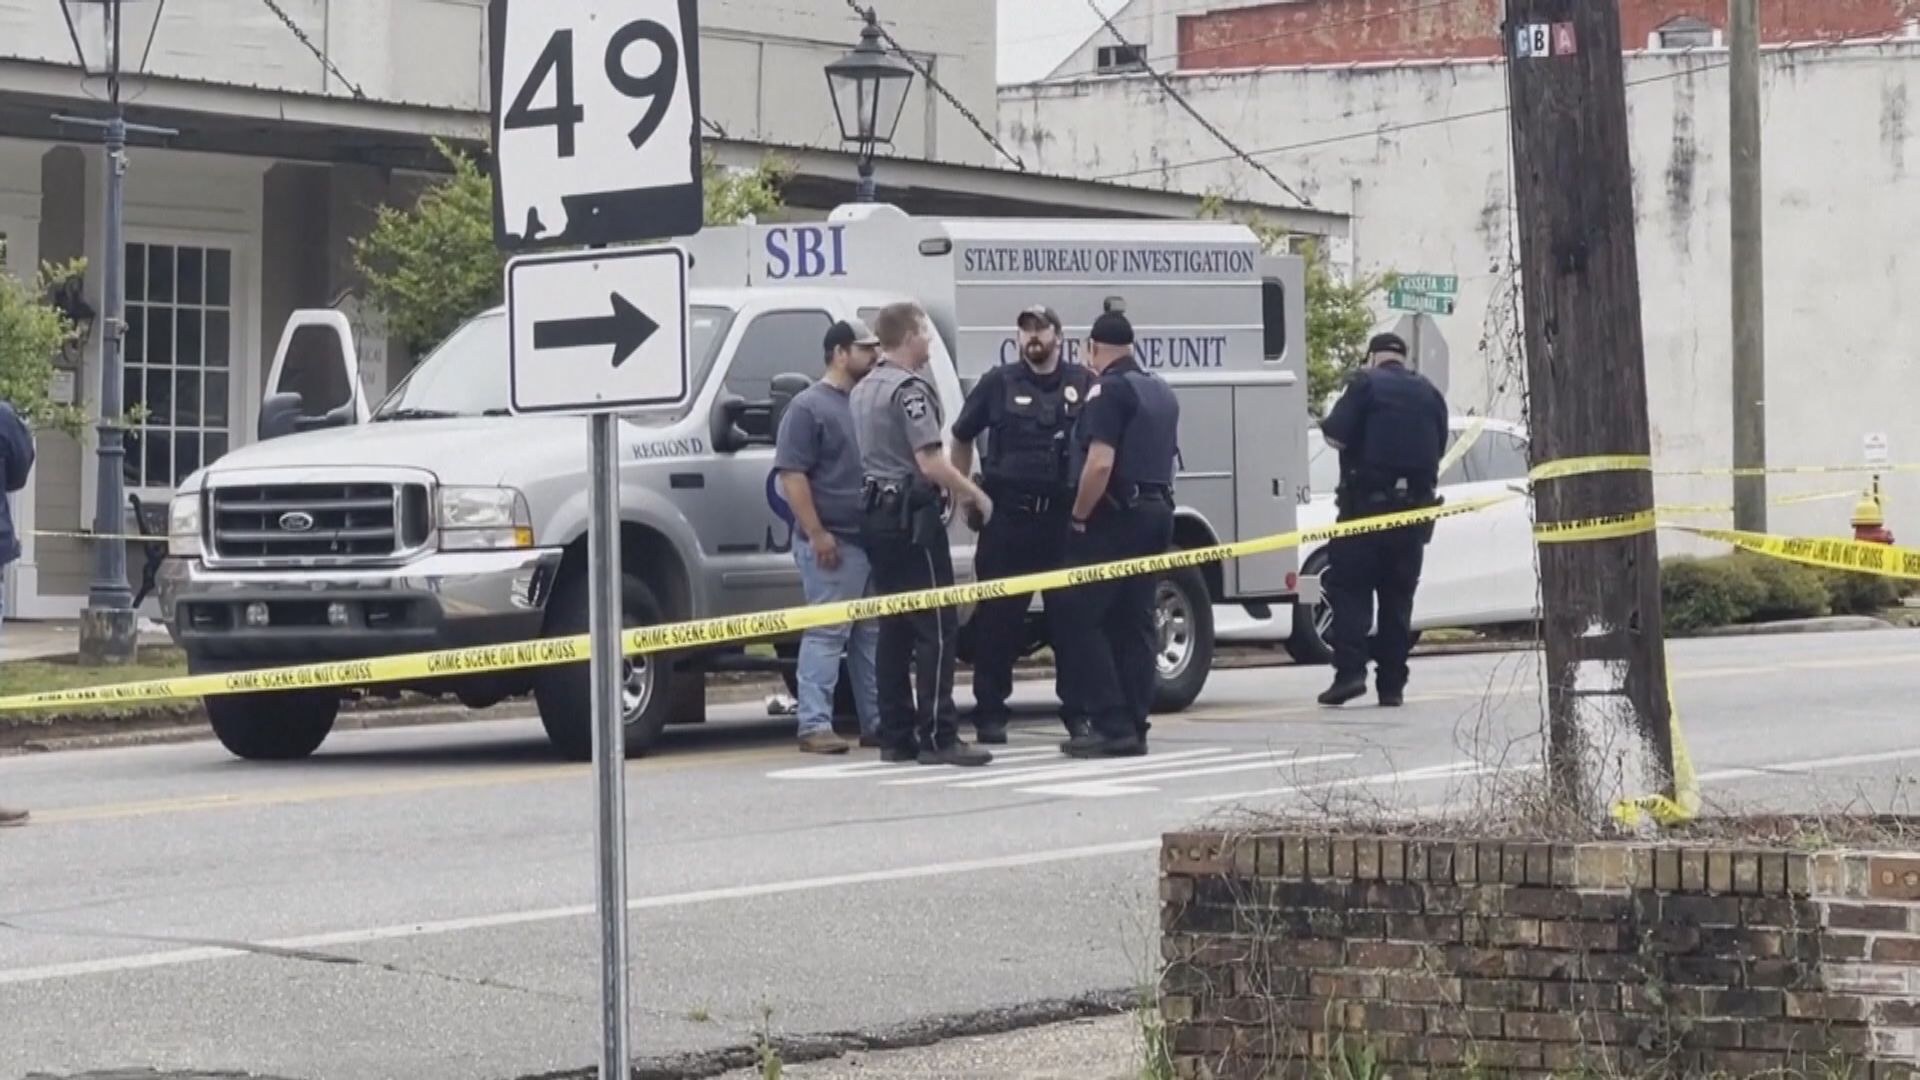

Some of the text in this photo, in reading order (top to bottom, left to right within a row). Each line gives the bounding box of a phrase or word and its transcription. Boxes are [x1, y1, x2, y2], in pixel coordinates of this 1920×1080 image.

[1534, 29, 1545, 52] B
[504, 19, 679, 158] 49
[765, 225, 847, 279] SBI
[964, 248, 1254, 273] STATE BUREAU OF INVESTIGATION
[1168, 336, 1227, 368] UNIT
[632, 437, 704, 459] REGION D
[847, 600, 883, 619] CRIME
[886, 594, 921, 614] SCENE
[633, 613, 788, 648] CRIME SCENE DO NOT CROSS
[427, 639, 576, 673] CRIME SCENE DO NOT CROSS
[226, 673, 259, 690] CRIME
[263, 670, 295, 687] SCENE
[314, 665, 334, 683] NOT
[337, 662, 372, 681] CROSS
